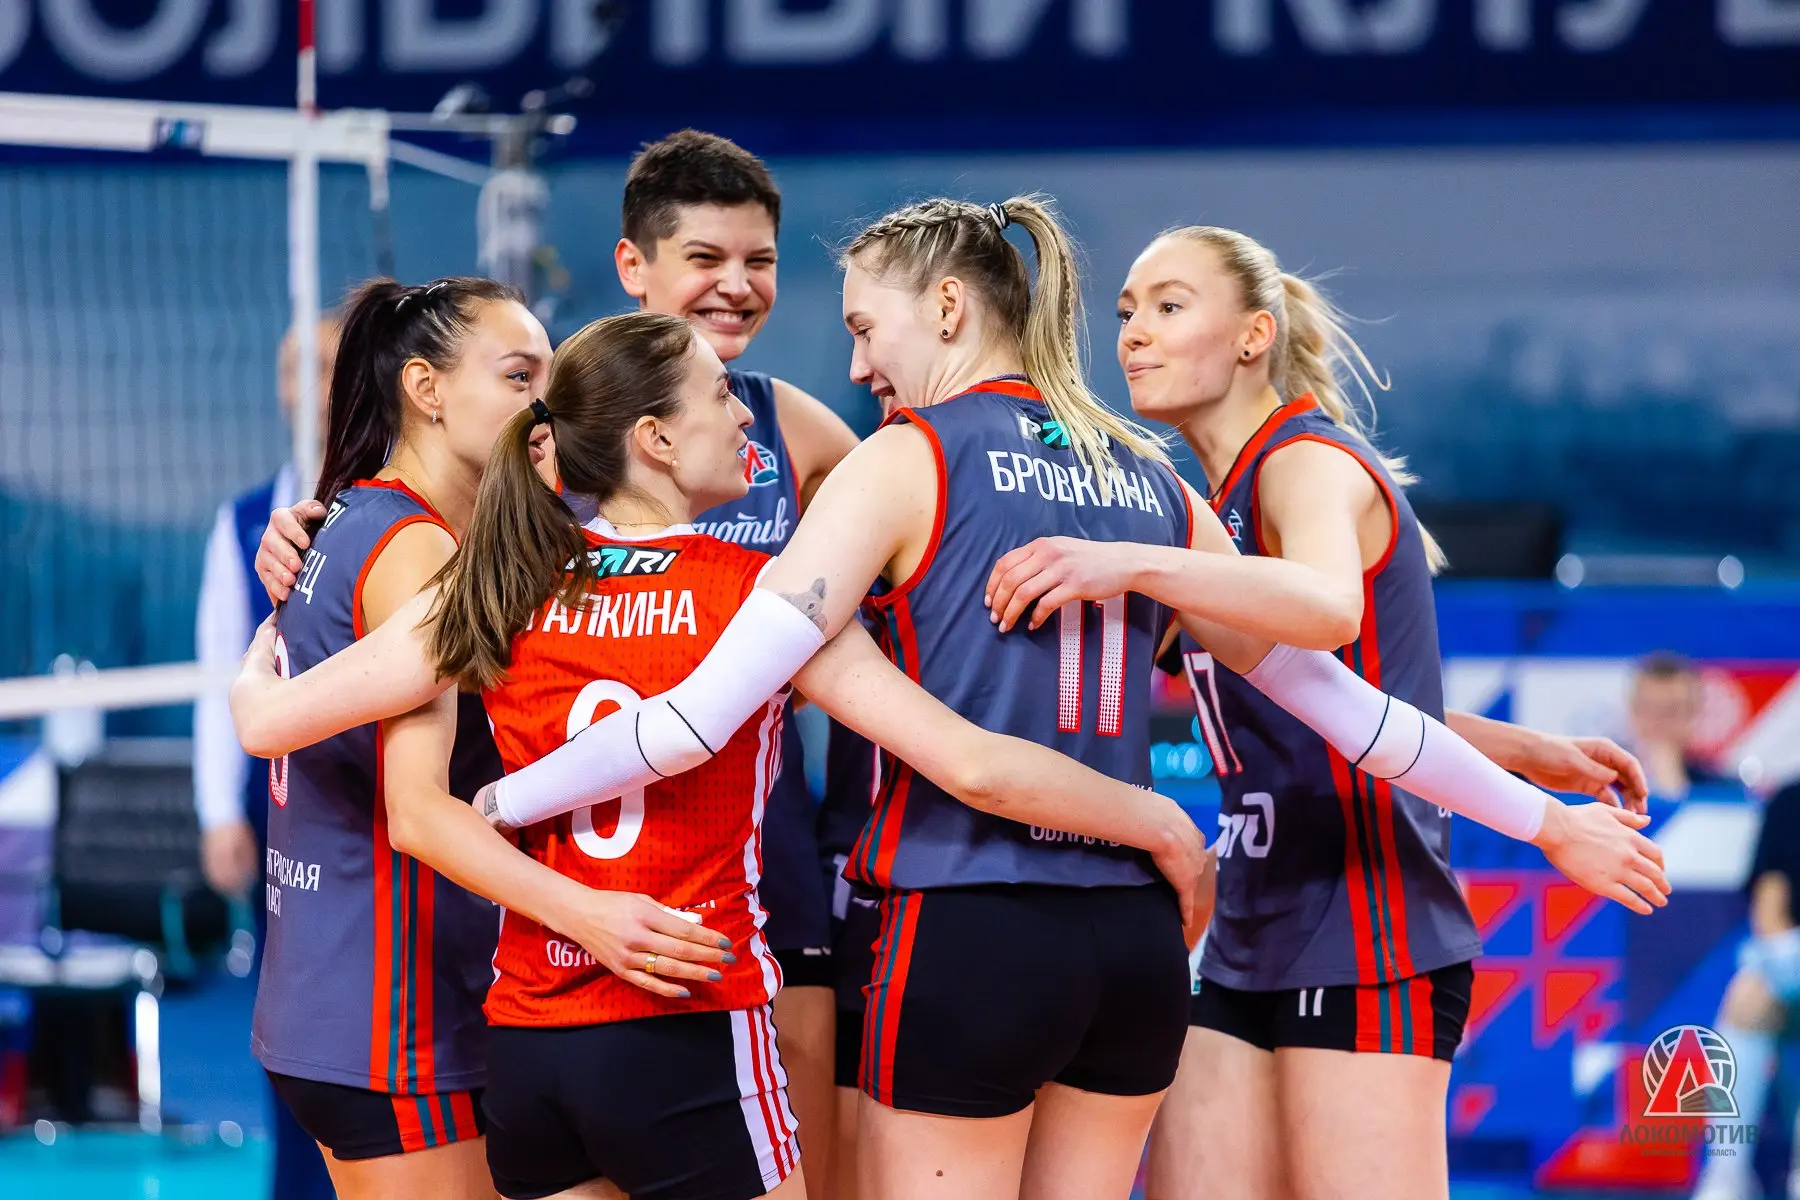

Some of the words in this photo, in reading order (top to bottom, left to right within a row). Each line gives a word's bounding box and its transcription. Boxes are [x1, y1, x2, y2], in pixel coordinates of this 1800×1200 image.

[986, 450, 1164, 517] БРОВКИНА
[526, 588, 698, 638] АЛКИНА
[1058, 588, 1128, 737] 11
[1182, 652, 1243, 777] 17
